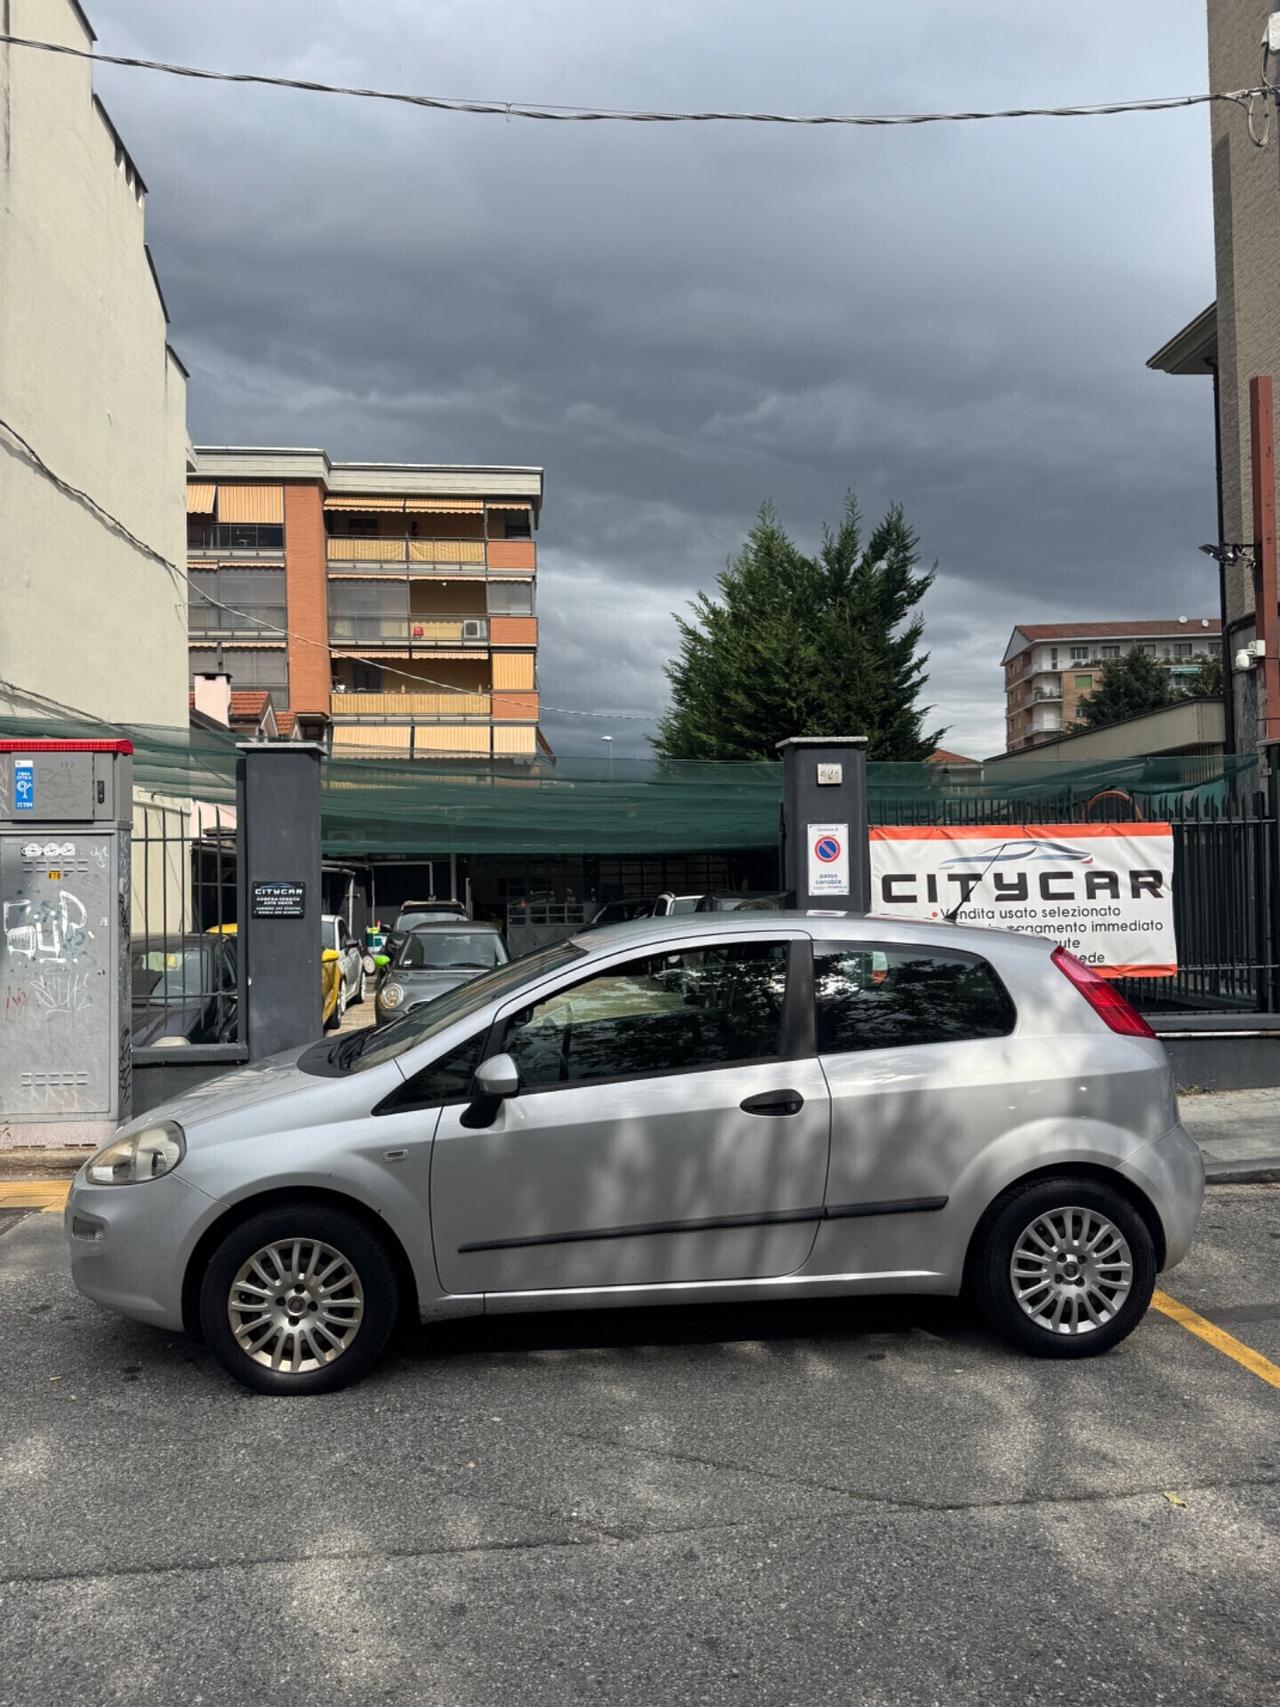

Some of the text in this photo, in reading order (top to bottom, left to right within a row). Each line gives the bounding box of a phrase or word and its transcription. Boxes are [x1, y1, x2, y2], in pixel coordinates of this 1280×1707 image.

[881, 869, 1165, 904] CITYCAR
[940, 905, 1121, 920] Vndita usato selezionato
[1091, 920, 1164, 933] immediato
[1076, 952, 1106, 963] ede
